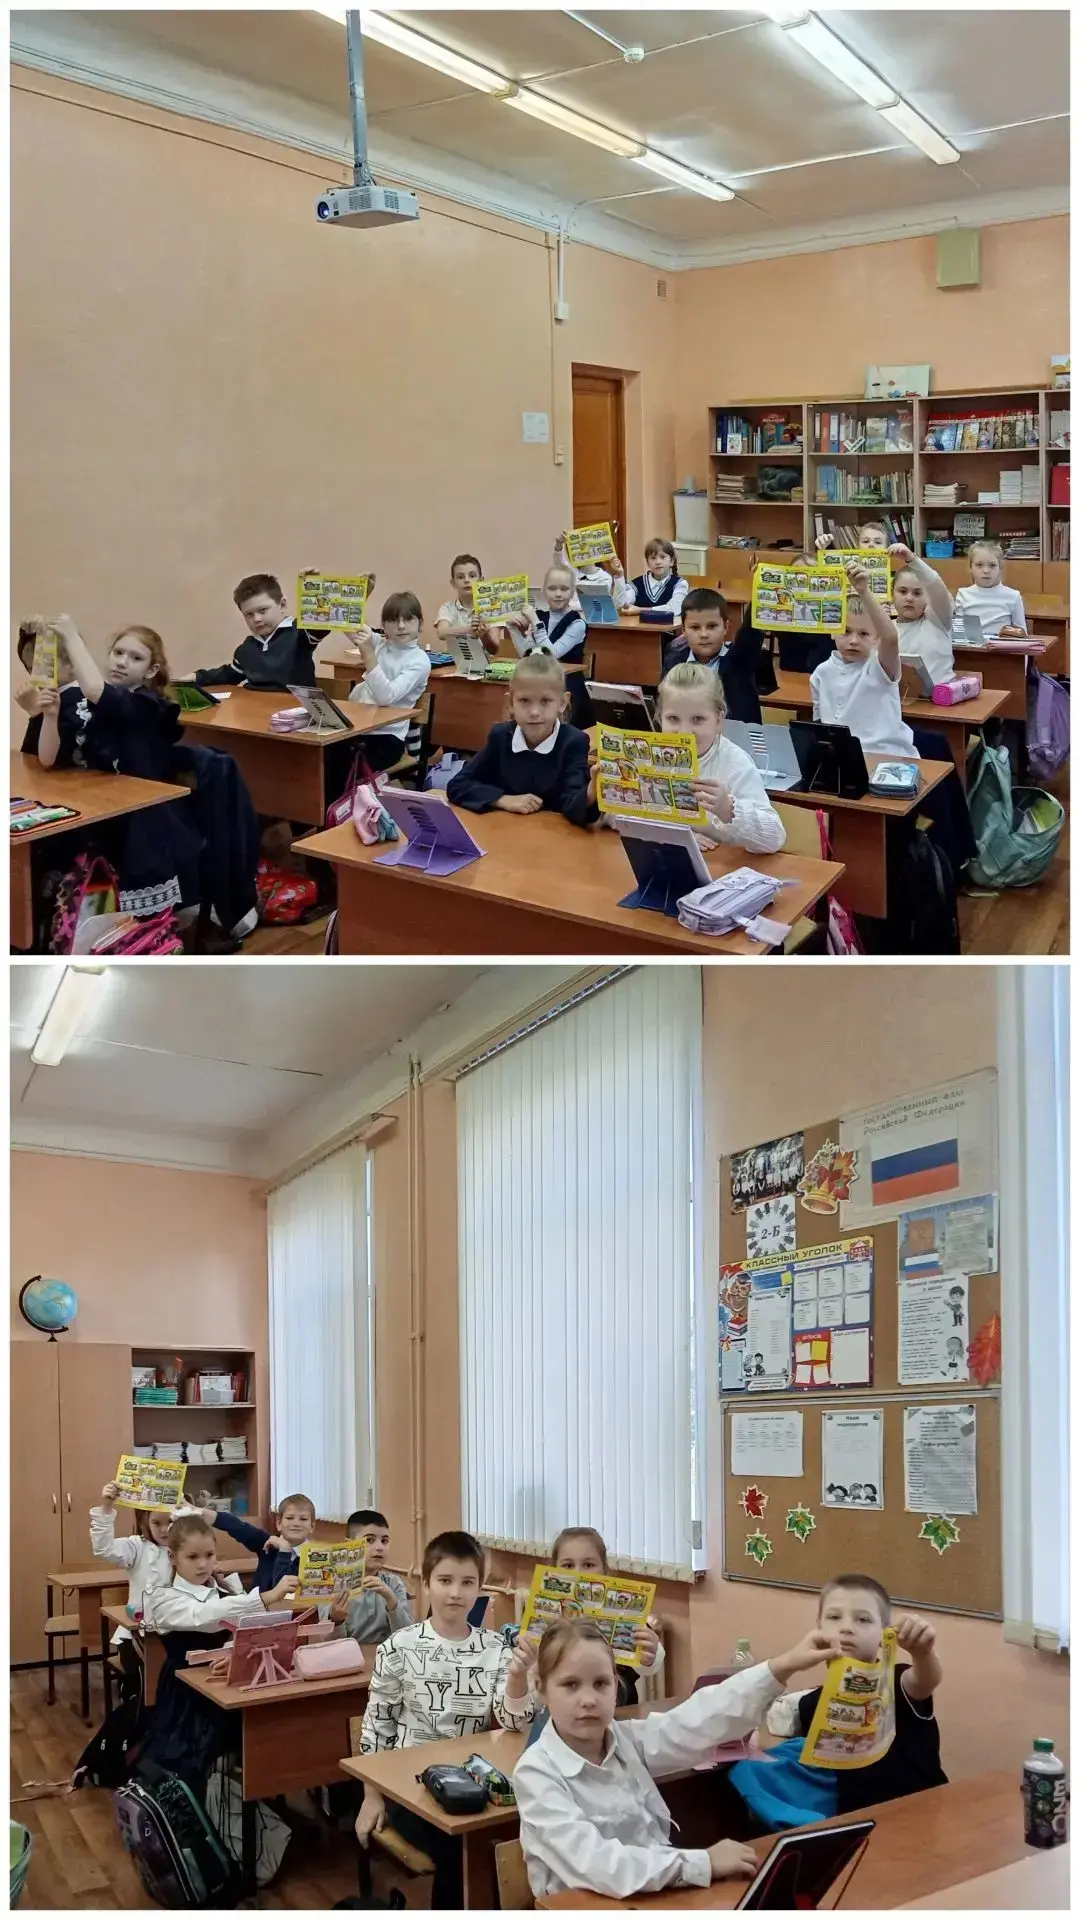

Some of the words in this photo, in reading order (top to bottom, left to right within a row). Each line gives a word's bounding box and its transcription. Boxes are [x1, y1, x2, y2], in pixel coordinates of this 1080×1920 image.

[761, 1225, 781, 1240] 2-Б
[746, 1252, 799, 1269] КЛАССНЫЙ
[802, 1243, 843, 1258] УГОЛОК
